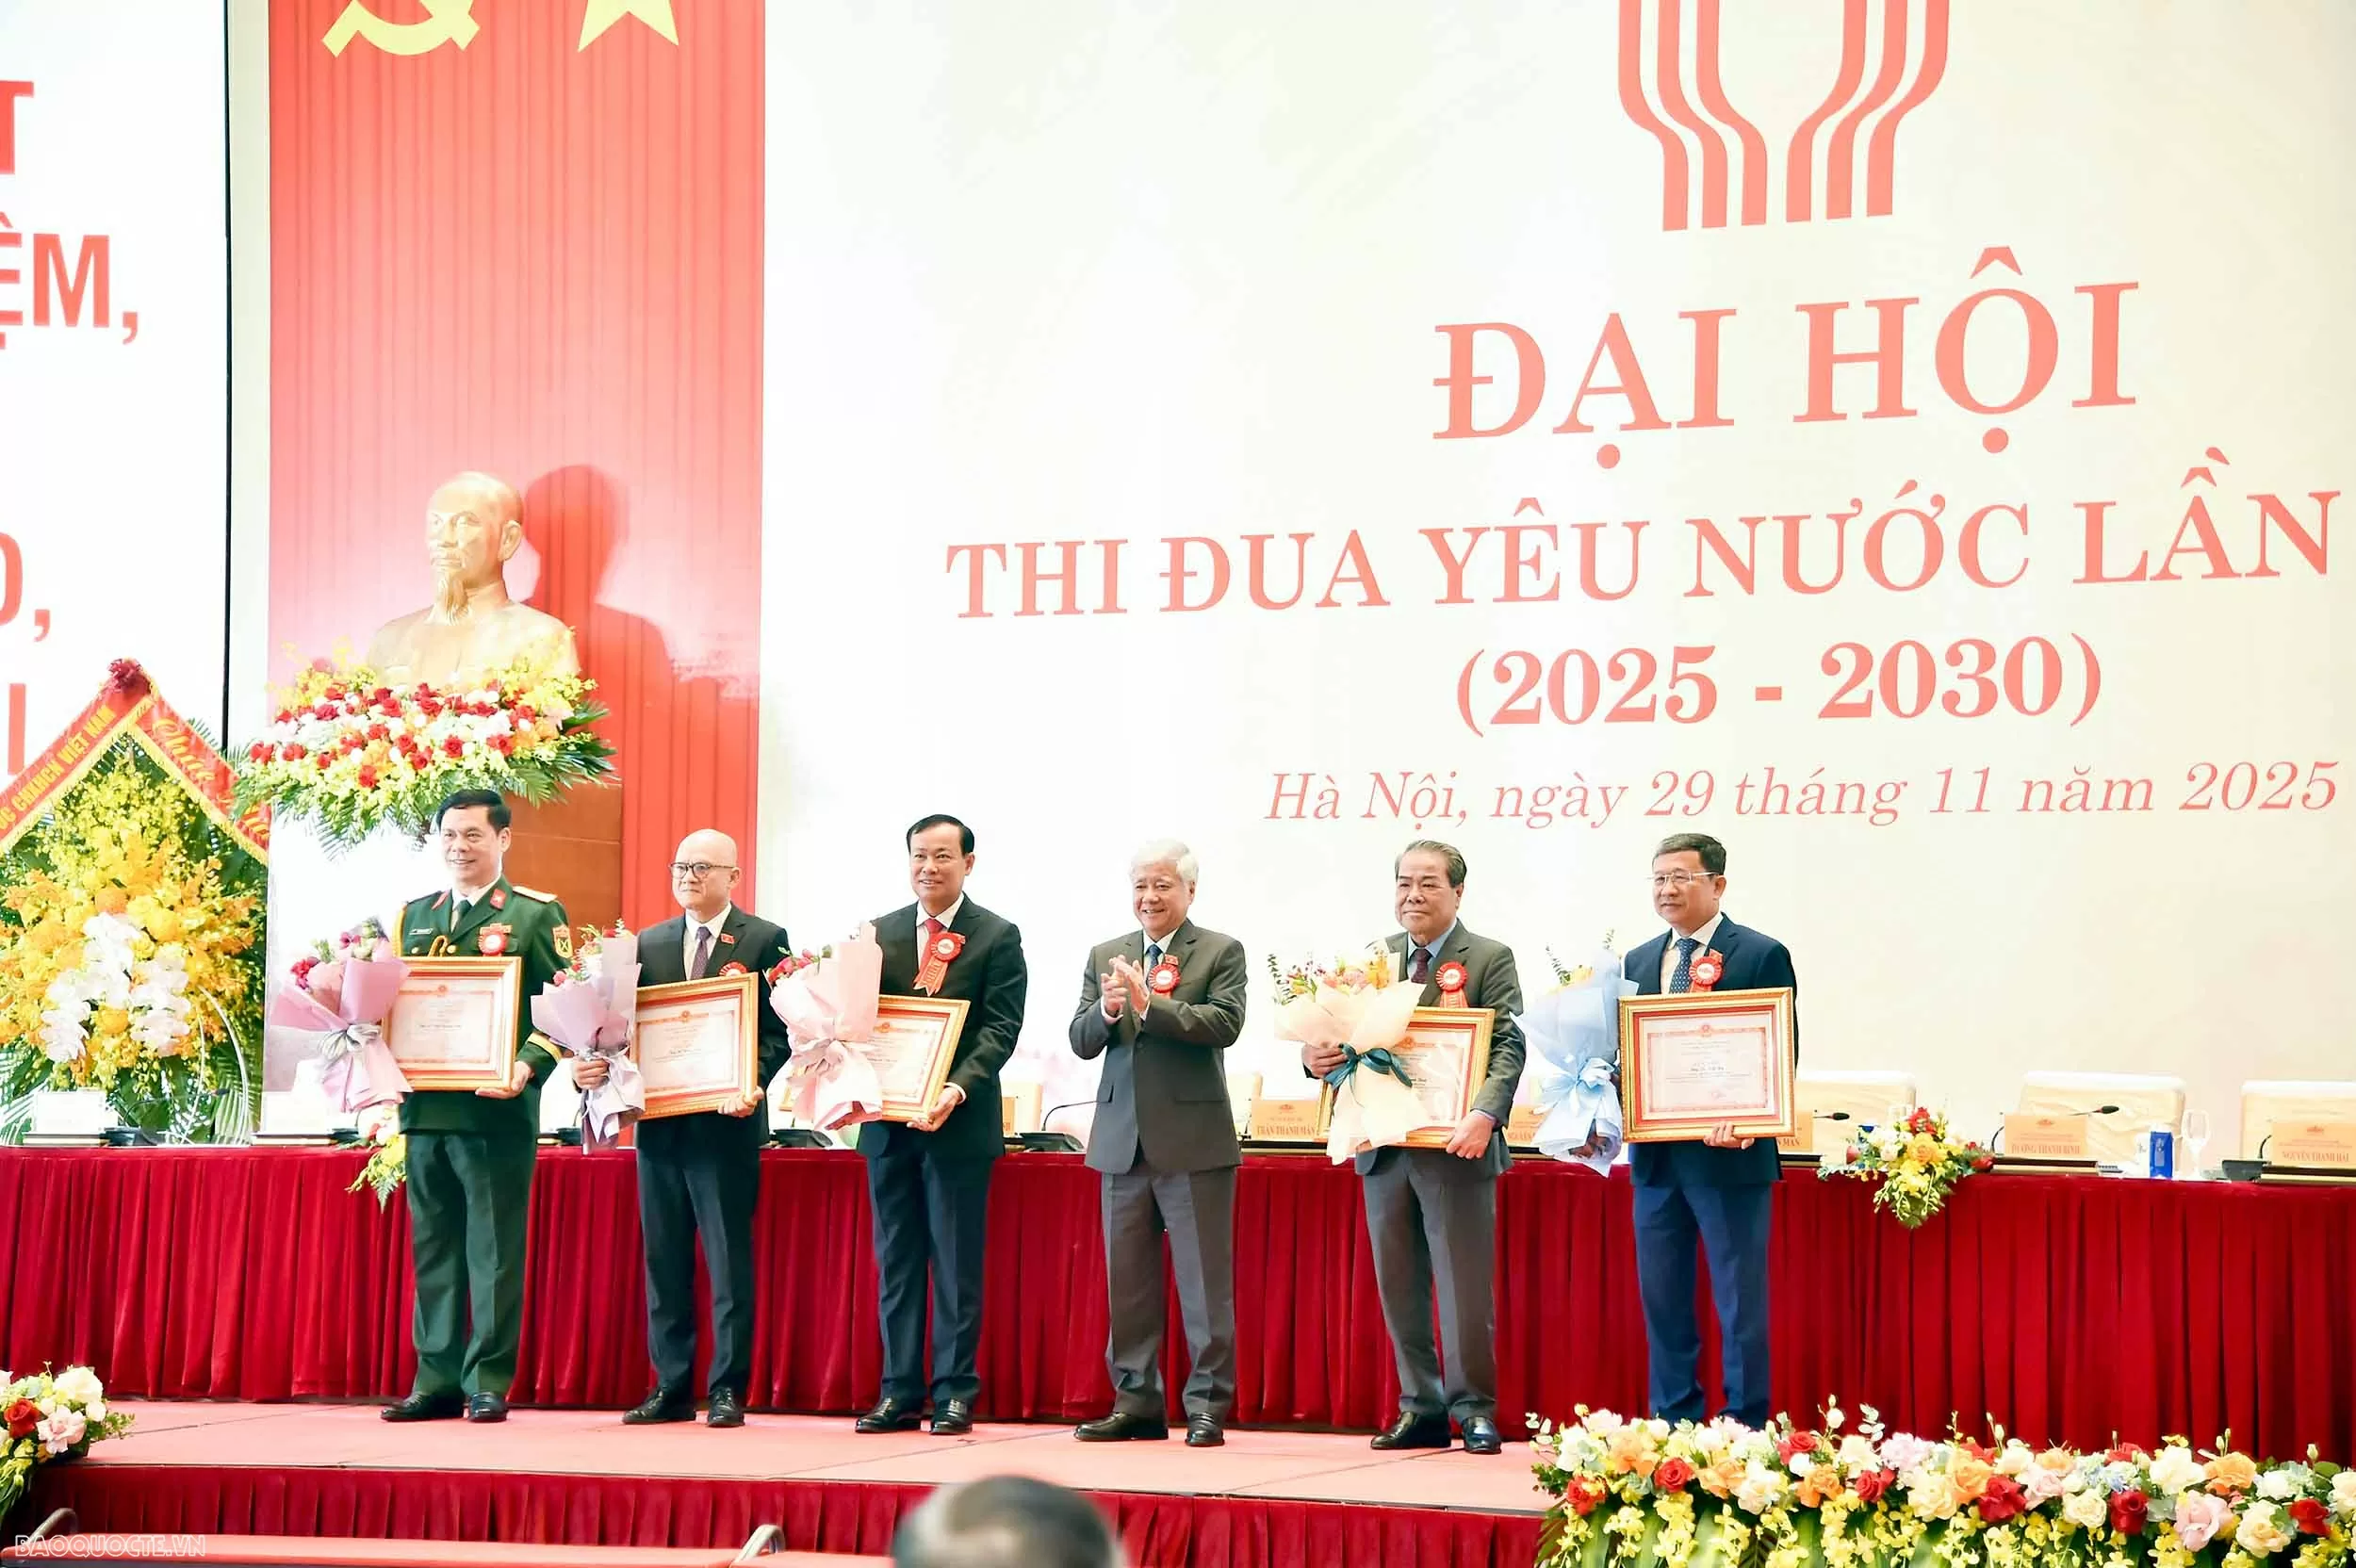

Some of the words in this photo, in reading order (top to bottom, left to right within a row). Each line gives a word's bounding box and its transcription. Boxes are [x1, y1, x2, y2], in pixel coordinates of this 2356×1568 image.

[1433, 309, 1737, 469] ĐẠI
[1794, 246, 2139, 454] HỘI
[946, 539, 1128, 618] THI
[1159, 530, 1391, 612] ĐUA
[1418, 498, 1650, 605] YÊU
[1683, 479, 2030, 597] NƯỚC
[2073, 447, 2342, 584] LẦN
[1457, 645, 1718, 737] (2025
[1755, 685, 1783, 702] -
[1818, 634, 2102, 726] 2030)
[1265, 772, 1340, 820] Hà
[1361, 771, 1468, 830] Nội,
[1489, 772, 1628, 829] ngày
[1644, 770, 1715, 816] 29
[1735, 766, 1907, 826] tháng
[1930, 766, 1991, 813] 11
[2017, 764, 2154, 813] năm
[2179, 760, 2339, 811] 2025
